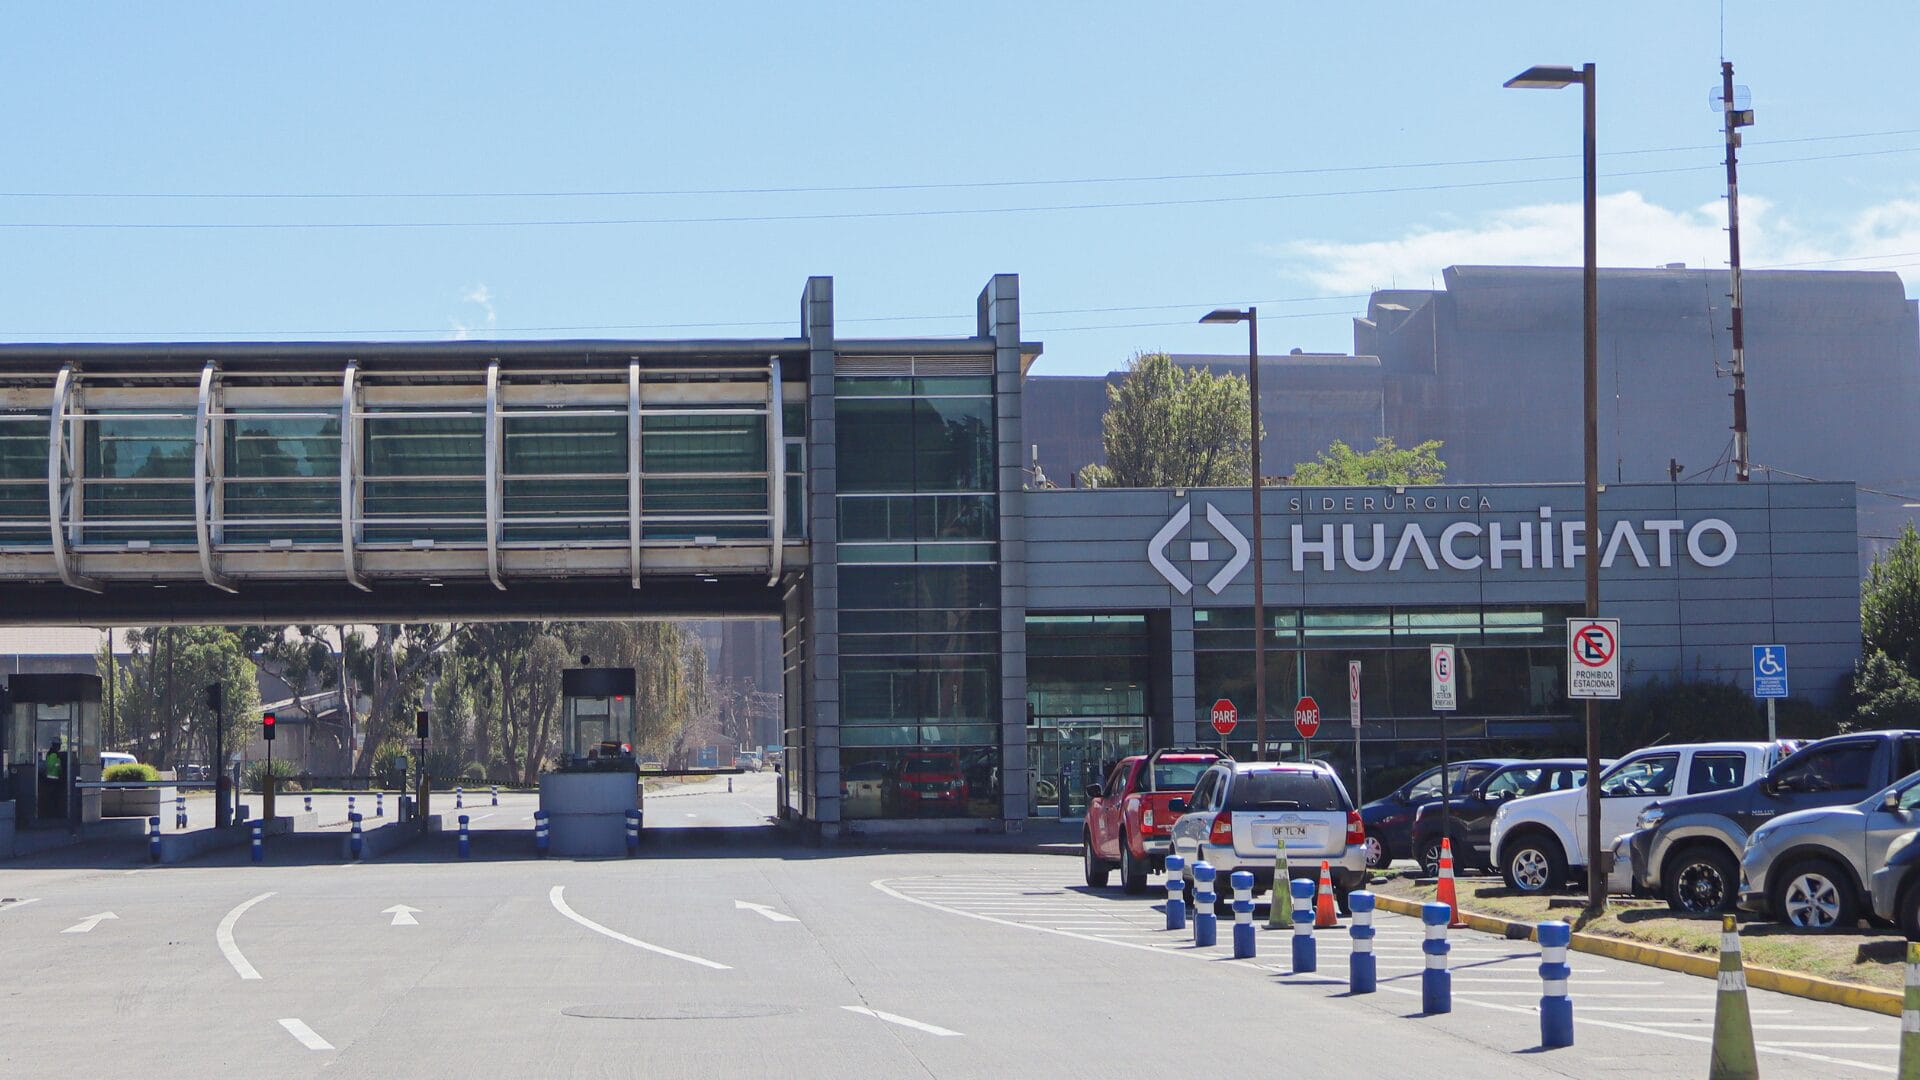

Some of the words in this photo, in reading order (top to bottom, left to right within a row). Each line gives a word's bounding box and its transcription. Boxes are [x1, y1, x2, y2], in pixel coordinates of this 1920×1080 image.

[1290, 494, 1491, 511] SIDERÚRGICA
[1576, 670, 1613, 680] PROHIBIDO
[1573, 679, 1616, 688] ESTACIONAR
[1213, 710, 1236, 724] PARE
[1296, 709, 1318, 725] PARE
